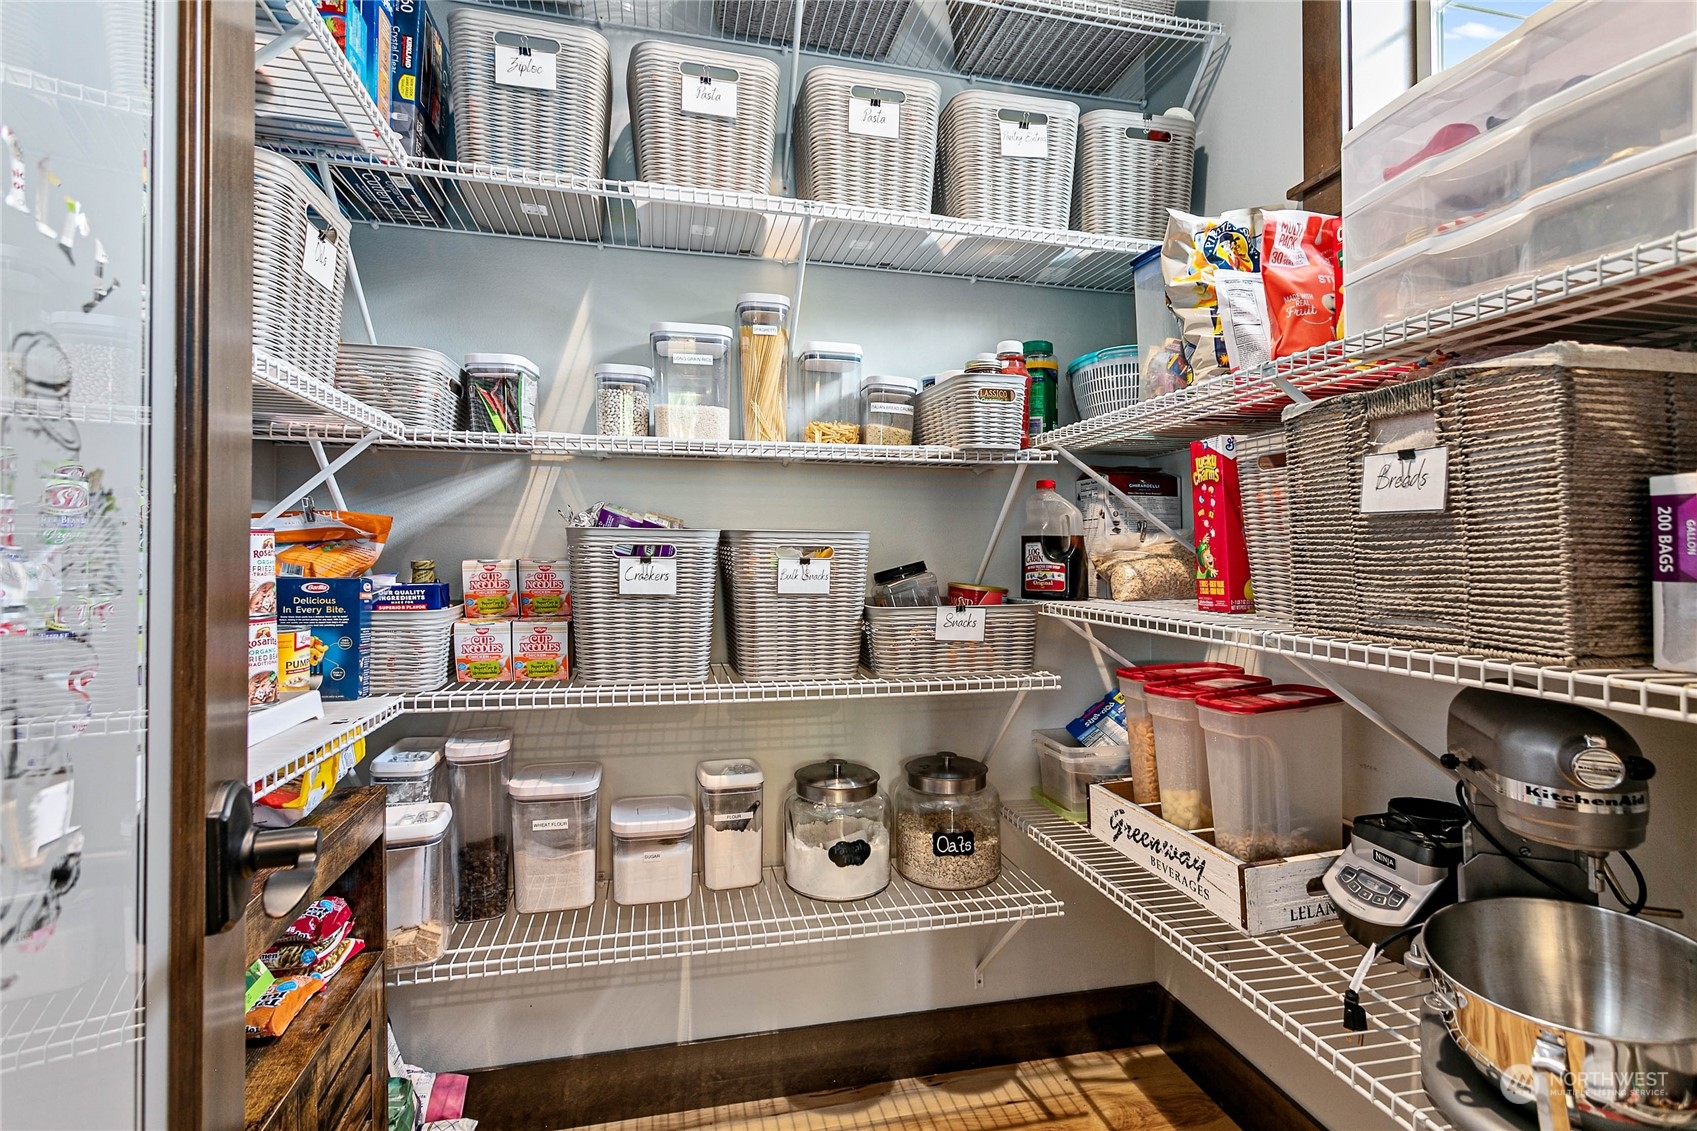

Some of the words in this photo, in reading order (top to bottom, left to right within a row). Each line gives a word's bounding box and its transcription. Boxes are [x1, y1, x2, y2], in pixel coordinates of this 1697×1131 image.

[392, 25, 400, 52] Crystal
[405, 36, 413, 68] KIRKLAND
[507, 57, 543, 77] Ziploc
[696, 86, 722, 101] Pasta
[862, 108, 886, 124] Pasta
[1281, 221, 1303, 237] MULTI
[1279, 233, 1298, 250] PACK
[1271, 251, 1284, 264] 30
[1284, 293, 1300, 304] MADE
[1300, 292, 1314, 300] WITH
[1286, 306, 1318, 318] Fruit
[674, 354, 687, 362] LONG
[980, 389, 1008, 398] LASSICO
[1376, 458, 1429, 491] Breads
[1657, 506, 1673, 531] 200
[1686, 519, 1697, 556] GALLON
[1025, 555, 1044, 563] CABIN
[1028, 548, 1040, 556] LOG
[1657, 535, 1674, 573] BAGS
[479, 572, 502, 580] CUP
[534, 572, 556, 581] CUP
[625, 565, 669, 581] Crackers
[780, 568, 799, 580] Bulk
[802, 569, 829, 581] Snacks
[470, 580, 510, 590] NOODLES
[525, 580, 564, 589] NOODLES
[293, 597, 336, 605] Delicious
[283, 606, 291, 614] In
[296, 606, 320, 616] Every
[326, 606, 346, 614] Bite.
[943, 612, 977, 628] Snacks
[471, 635, 495, 644] CUP
[529, 634, 553, 643] CUP
[461, 643, 504, 654] NOODLES
[519, 642, 561, 652] NOODLES
[1525, 785, 1644, 807] KitchenAid
[936, 835, 972, 853] Oats
[1109, 808, 1207, 882] Greenway
[1375, 851, 1394, 866] NINJA
[1149, 855, 1211, 901] BEVERAGES
[1290, 902, 1337, 922] LELAN
